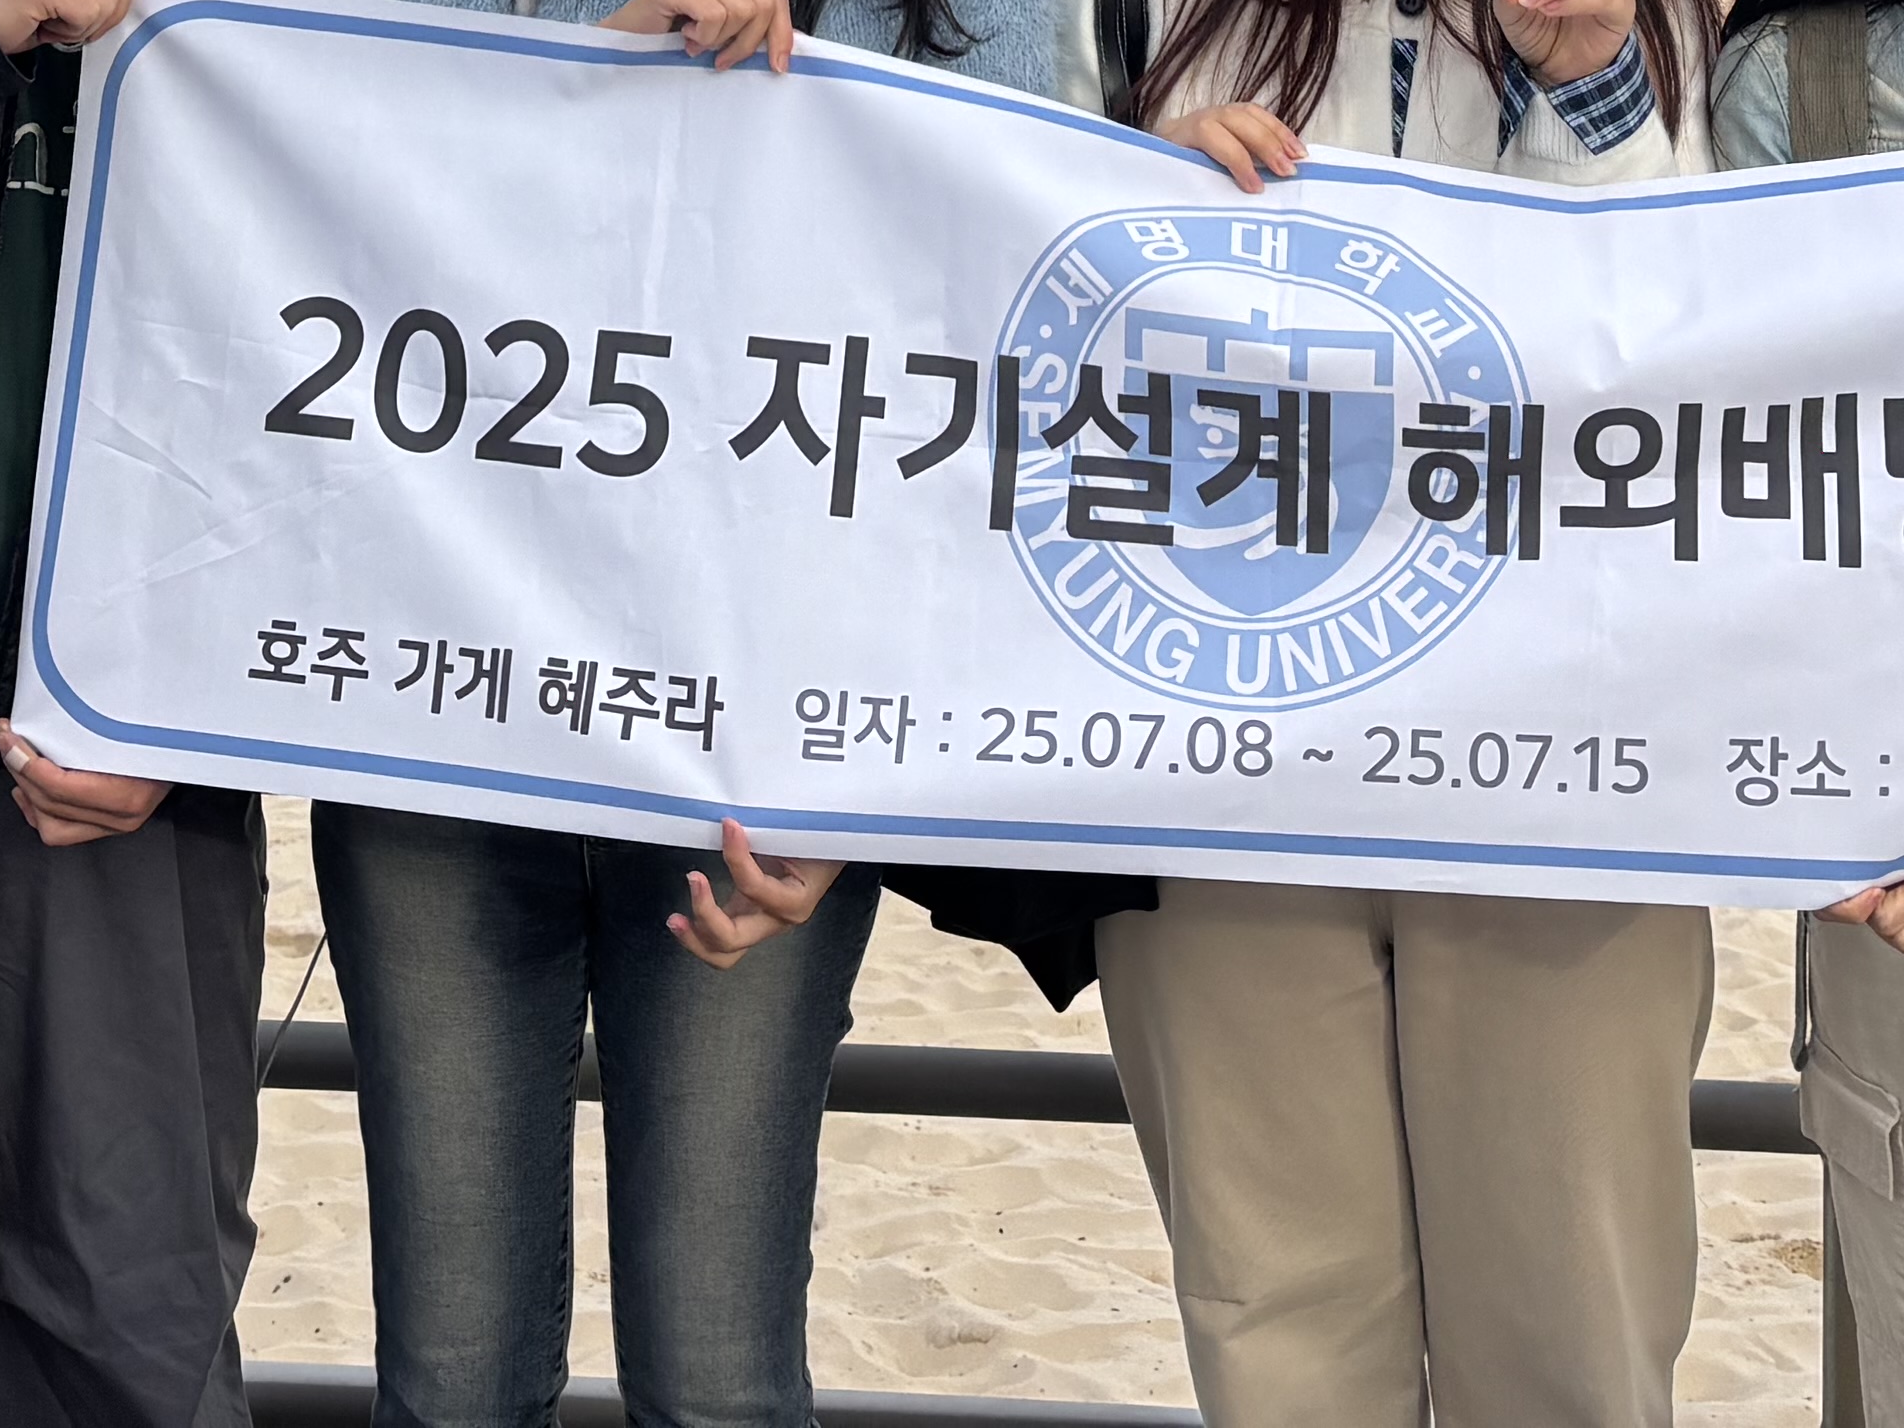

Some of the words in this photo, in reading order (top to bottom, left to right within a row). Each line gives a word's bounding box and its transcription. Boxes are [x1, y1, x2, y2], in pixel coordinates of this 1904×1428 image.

[1045, 217, 1482, 360] 세명대학교
[264, 296, 673, 477] 2025
[728, 335, 1332, 555] 자기설계
[247, 619, 369, 703] 호주
[394, 638, 513, 725] 가게
[538, 655, 726, 752] 혜주라
[794, 687, 918, 765] 일자
[938, 711, 954, 754] :
[976, 706, 1274, 778] 25.07.08
[1301, 747, 1335, 763] ~
[1361, 726, 1651, 795] 25.07.15
[1725, 735, 1852, 808] 장소
[1878, 753, 1892, 798] :
